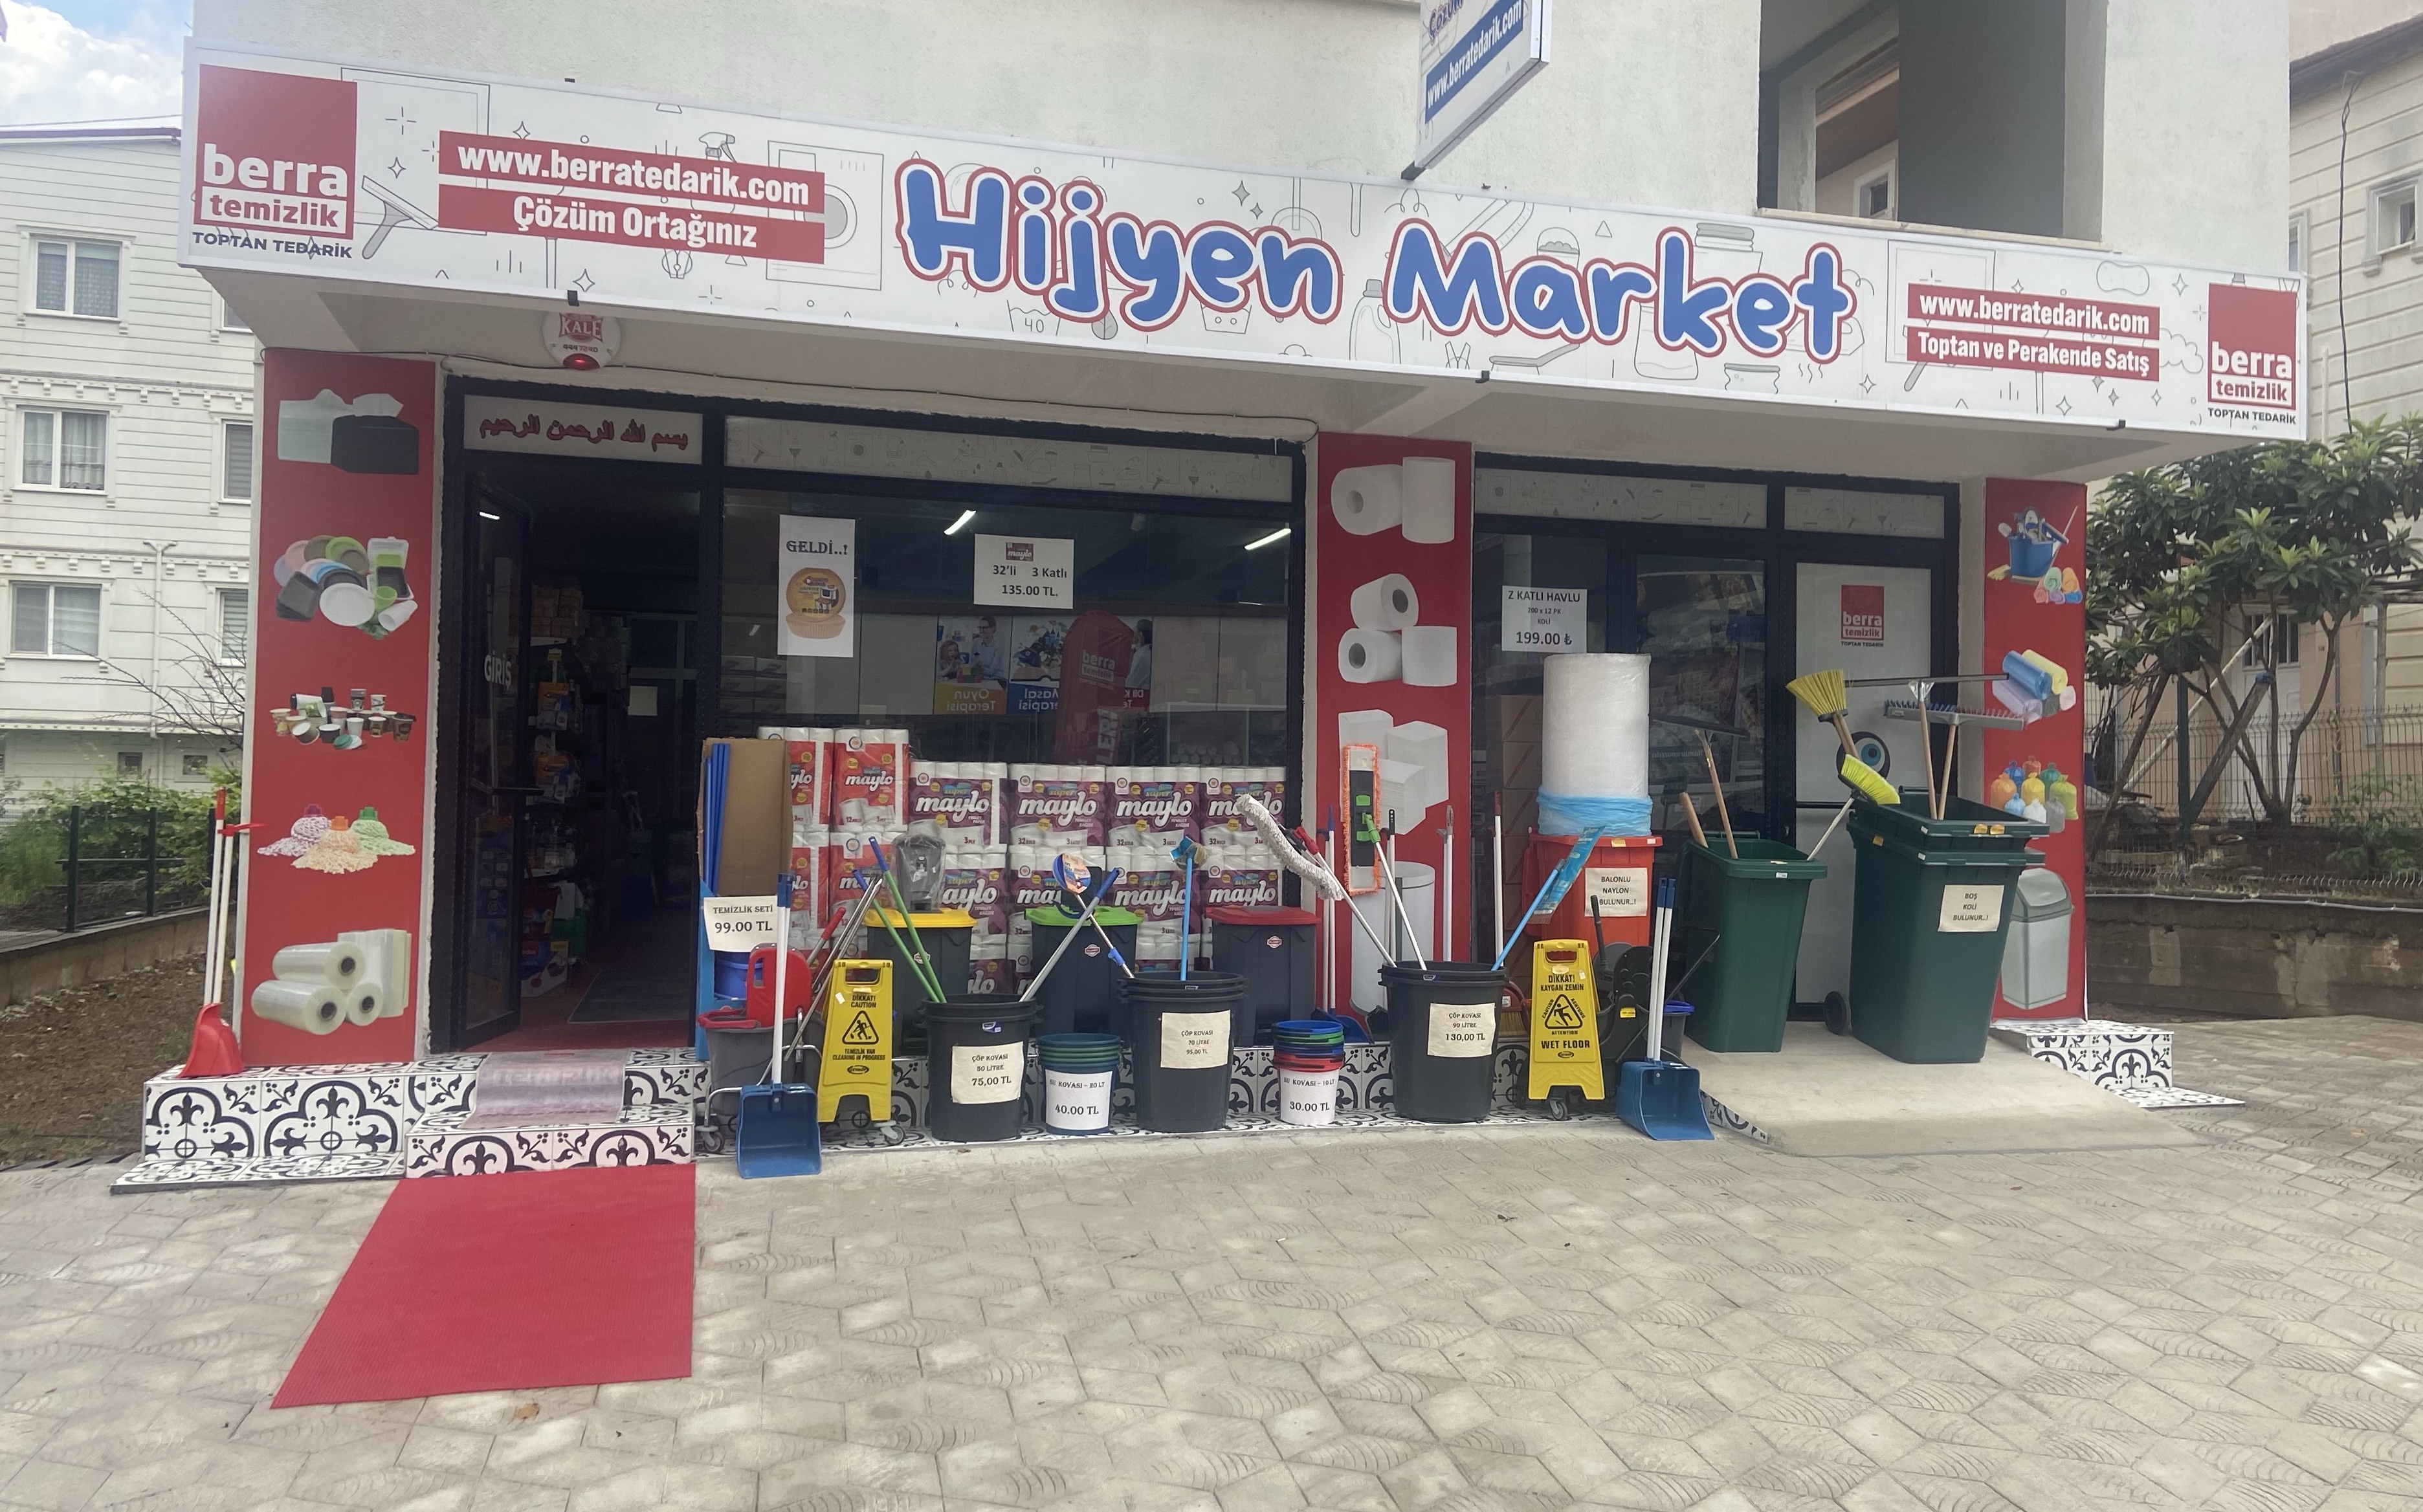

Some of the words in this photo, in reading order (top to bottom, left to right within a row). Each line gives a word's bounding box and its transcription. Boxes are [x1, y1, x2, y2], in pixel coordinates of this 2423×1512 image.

[1428, 1, 1521, 108] www.berratedarik.com
[201, 143, 348, 197] berra
[458, 146, 809, 205] www.berratedarik.com
[210, 193, 338, 228] temizlik
[513, 195, 615, 235] Çözüm
[623, 206, 757, 248] Ortağınız
[193, 232, 267, 251] TOPTAN
[272, 239, 352, 258] TEDARİK
[898, 162, 1342, 329] Hijyen
[1385, 220, 1855, 361] Market
[1919, 294, 2150, 334] www.berratedarik.com
[561, 315, 602, 340] KALE
[1918, 331, 1979, 362] Toptan
[1982, 340, 2004, 360] ve
[2008, 338, 2101, 369] Perakende
[2105, 348, 2150, 377] Satış
[2211, 341, 2292, 378] berra
[2216, 378, 2287, 402] temizlik
[480, 413, 541, 439] الرحيم
[2207, 408, 2249, 422] TOPTAN
[2252, 411, 2296, 425] TEDARİK
[546, 419, 615, 444] الرحمن
[620, 418, 646, 443] الله
[651, 432, 689, 452] بسم
[1008, 549, 1032, 560] maylo
[993, 565, 1016, 576] 32'li
[1032, 567, 1038, 576] 3
[1043, 567, 1067, 578] Katlı
[1002, 584, 1039, 596] 135.00
[1043, 586, 1058, 597] TL.
[1508, 590, 1514, 600] Z
[1517, 591, 1543, 601] KATLI
[1547, 592, 1580, 602] HAVLU
[1842, 611, 1883, 626] berra
[1516, 631, 1560, 645] 199.00
[1845, 628, 1880, 637] temizlik
[1082, 650, 1116, 670] berra
[845, 771, 893, 791] maylo
[915, 790, 990, 823] maylo
[1019, 791, 1097, 827] maylo
[1116, 791, 1192, 827] maylo
[942, 879, 997, 912] aylo
[713, 904, 753, 915] TEMİZLİK
[755, 904, 773, 913] SETİ
[714, 921, 753, 934] 99.00
[756, 921, 773, 932] TL
[1448, 1011, 1460, 1020] ÇÖP
[1445, 1033, 1474, 1042] 130,00
[1476, 1033, 1485, 1041] TL
[1541, 1040, 1560, 1049] WET
[1563, 1040, 1590, 1048] FLOOR
[971, 1054, 985, 1063] ÇÖP
[971, 1077, 999, 1087] 75,00
[1001, 1076, 1012, 1084] TL
[1058, 1080, 1083, 1089] KOVASI
[1055, 1104, 1084, 1115] 40.00
[1087, 1106, 1099, 1115] TL
[1289, 1101, 1318, 1112] 30.00
[1320, 1102, 1330, 1111] TL
